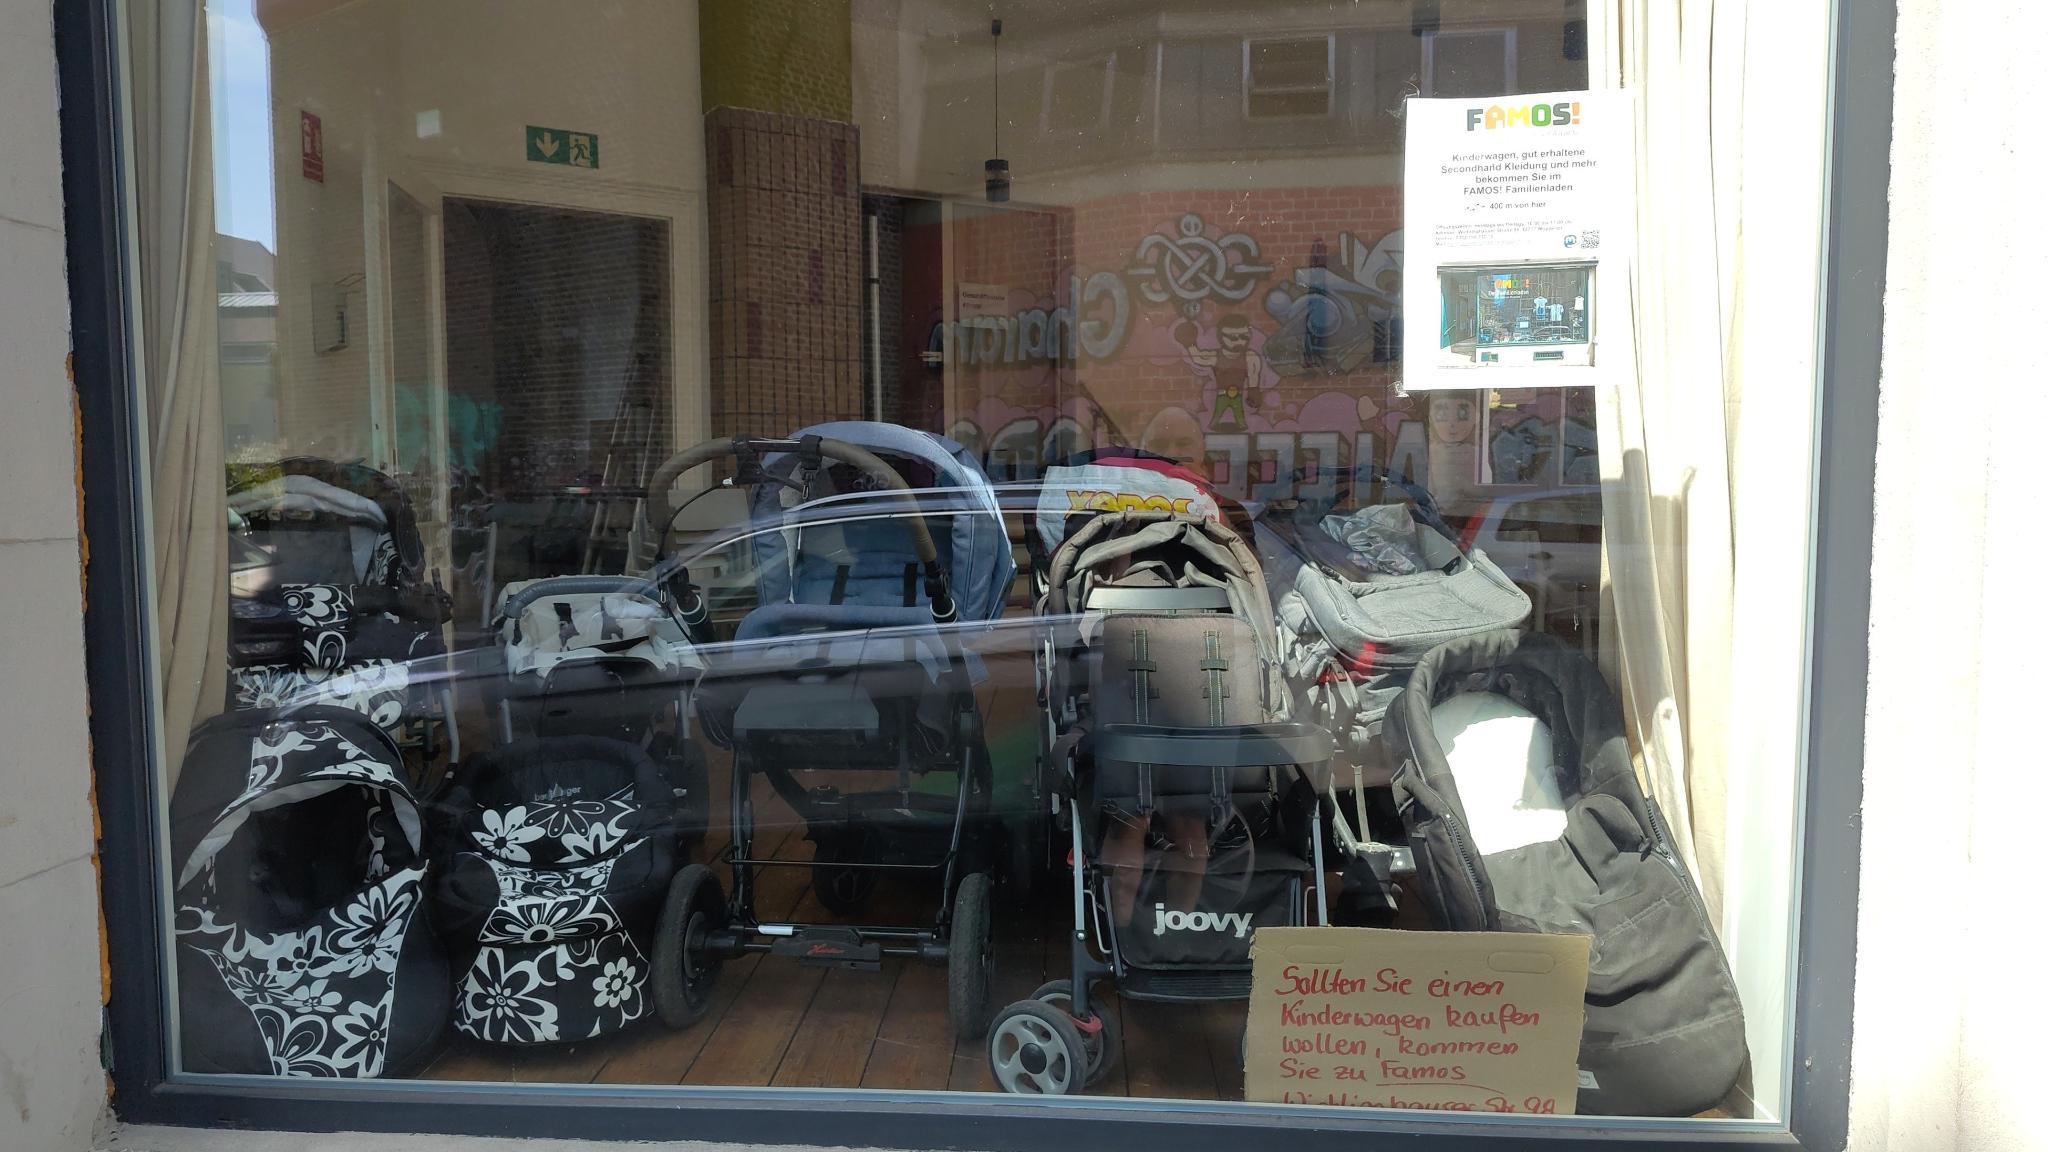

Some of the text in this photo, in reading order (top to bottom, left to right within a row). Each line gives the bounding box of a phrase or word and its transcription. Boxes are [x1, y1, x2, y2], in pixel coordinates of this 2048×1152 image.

[1466, 102, 1580, 131] FAMOS!
[1521, 151, 1537, 160] gut
[1540, 148, 1585, 158] erhaltene
[1441, 159, 1597, 174] Secondhand Kleidung und mehr
[1475, 175, 1529, 183] bekommen
[1531, 172, 1547, 181] Sie
[1463, 183, 1573, 195] FAMOS! Familienladen
[1153, 902, 1254, 938] joovy
[1274, 965, 1505, 997] Sollten Sie einen
[1281, 999, 1540, 1036] Kinderwagen kaufen
[1398, 1035, 1519, 1056] kommen
[1279, 1057, 1467, 1082] Sie zu Famos
